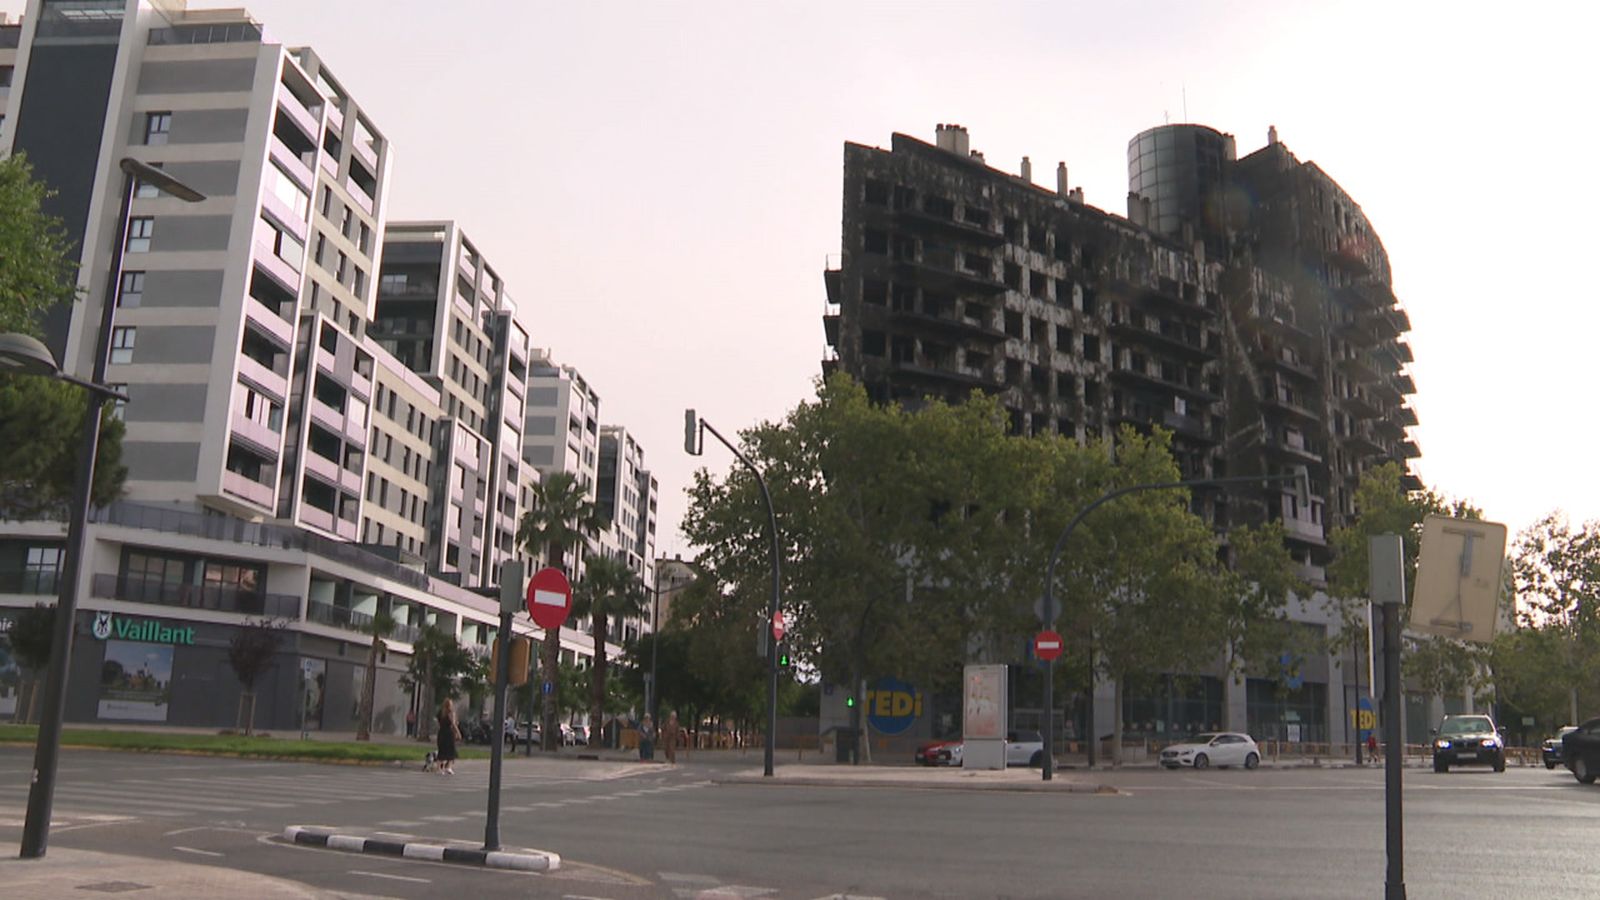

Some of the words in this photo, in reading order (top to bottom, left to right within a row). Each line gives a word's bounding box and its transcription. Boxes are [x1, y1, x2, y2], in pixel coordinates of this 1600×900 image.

[115, 618, 195, 645] Vaillant
[864, 689, 923, 717] TEDi
[1350, 708, 1377, 729] TEDi
